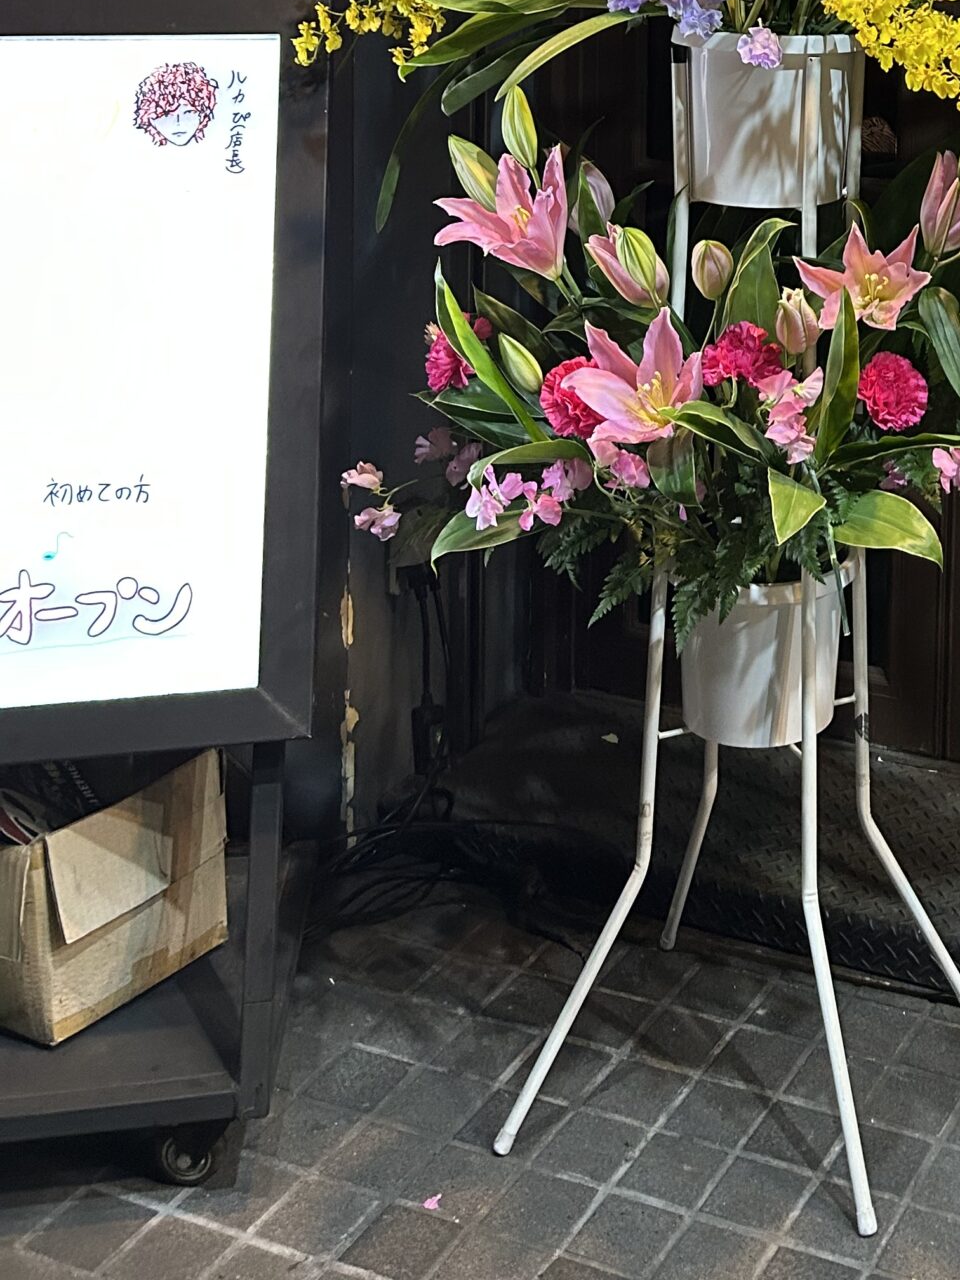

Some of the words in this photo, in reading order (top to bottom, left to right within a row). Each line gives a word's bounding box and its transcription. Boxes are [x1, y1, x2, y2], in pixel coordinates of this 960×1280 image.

[42, 473, 152, 508] 初めての方
